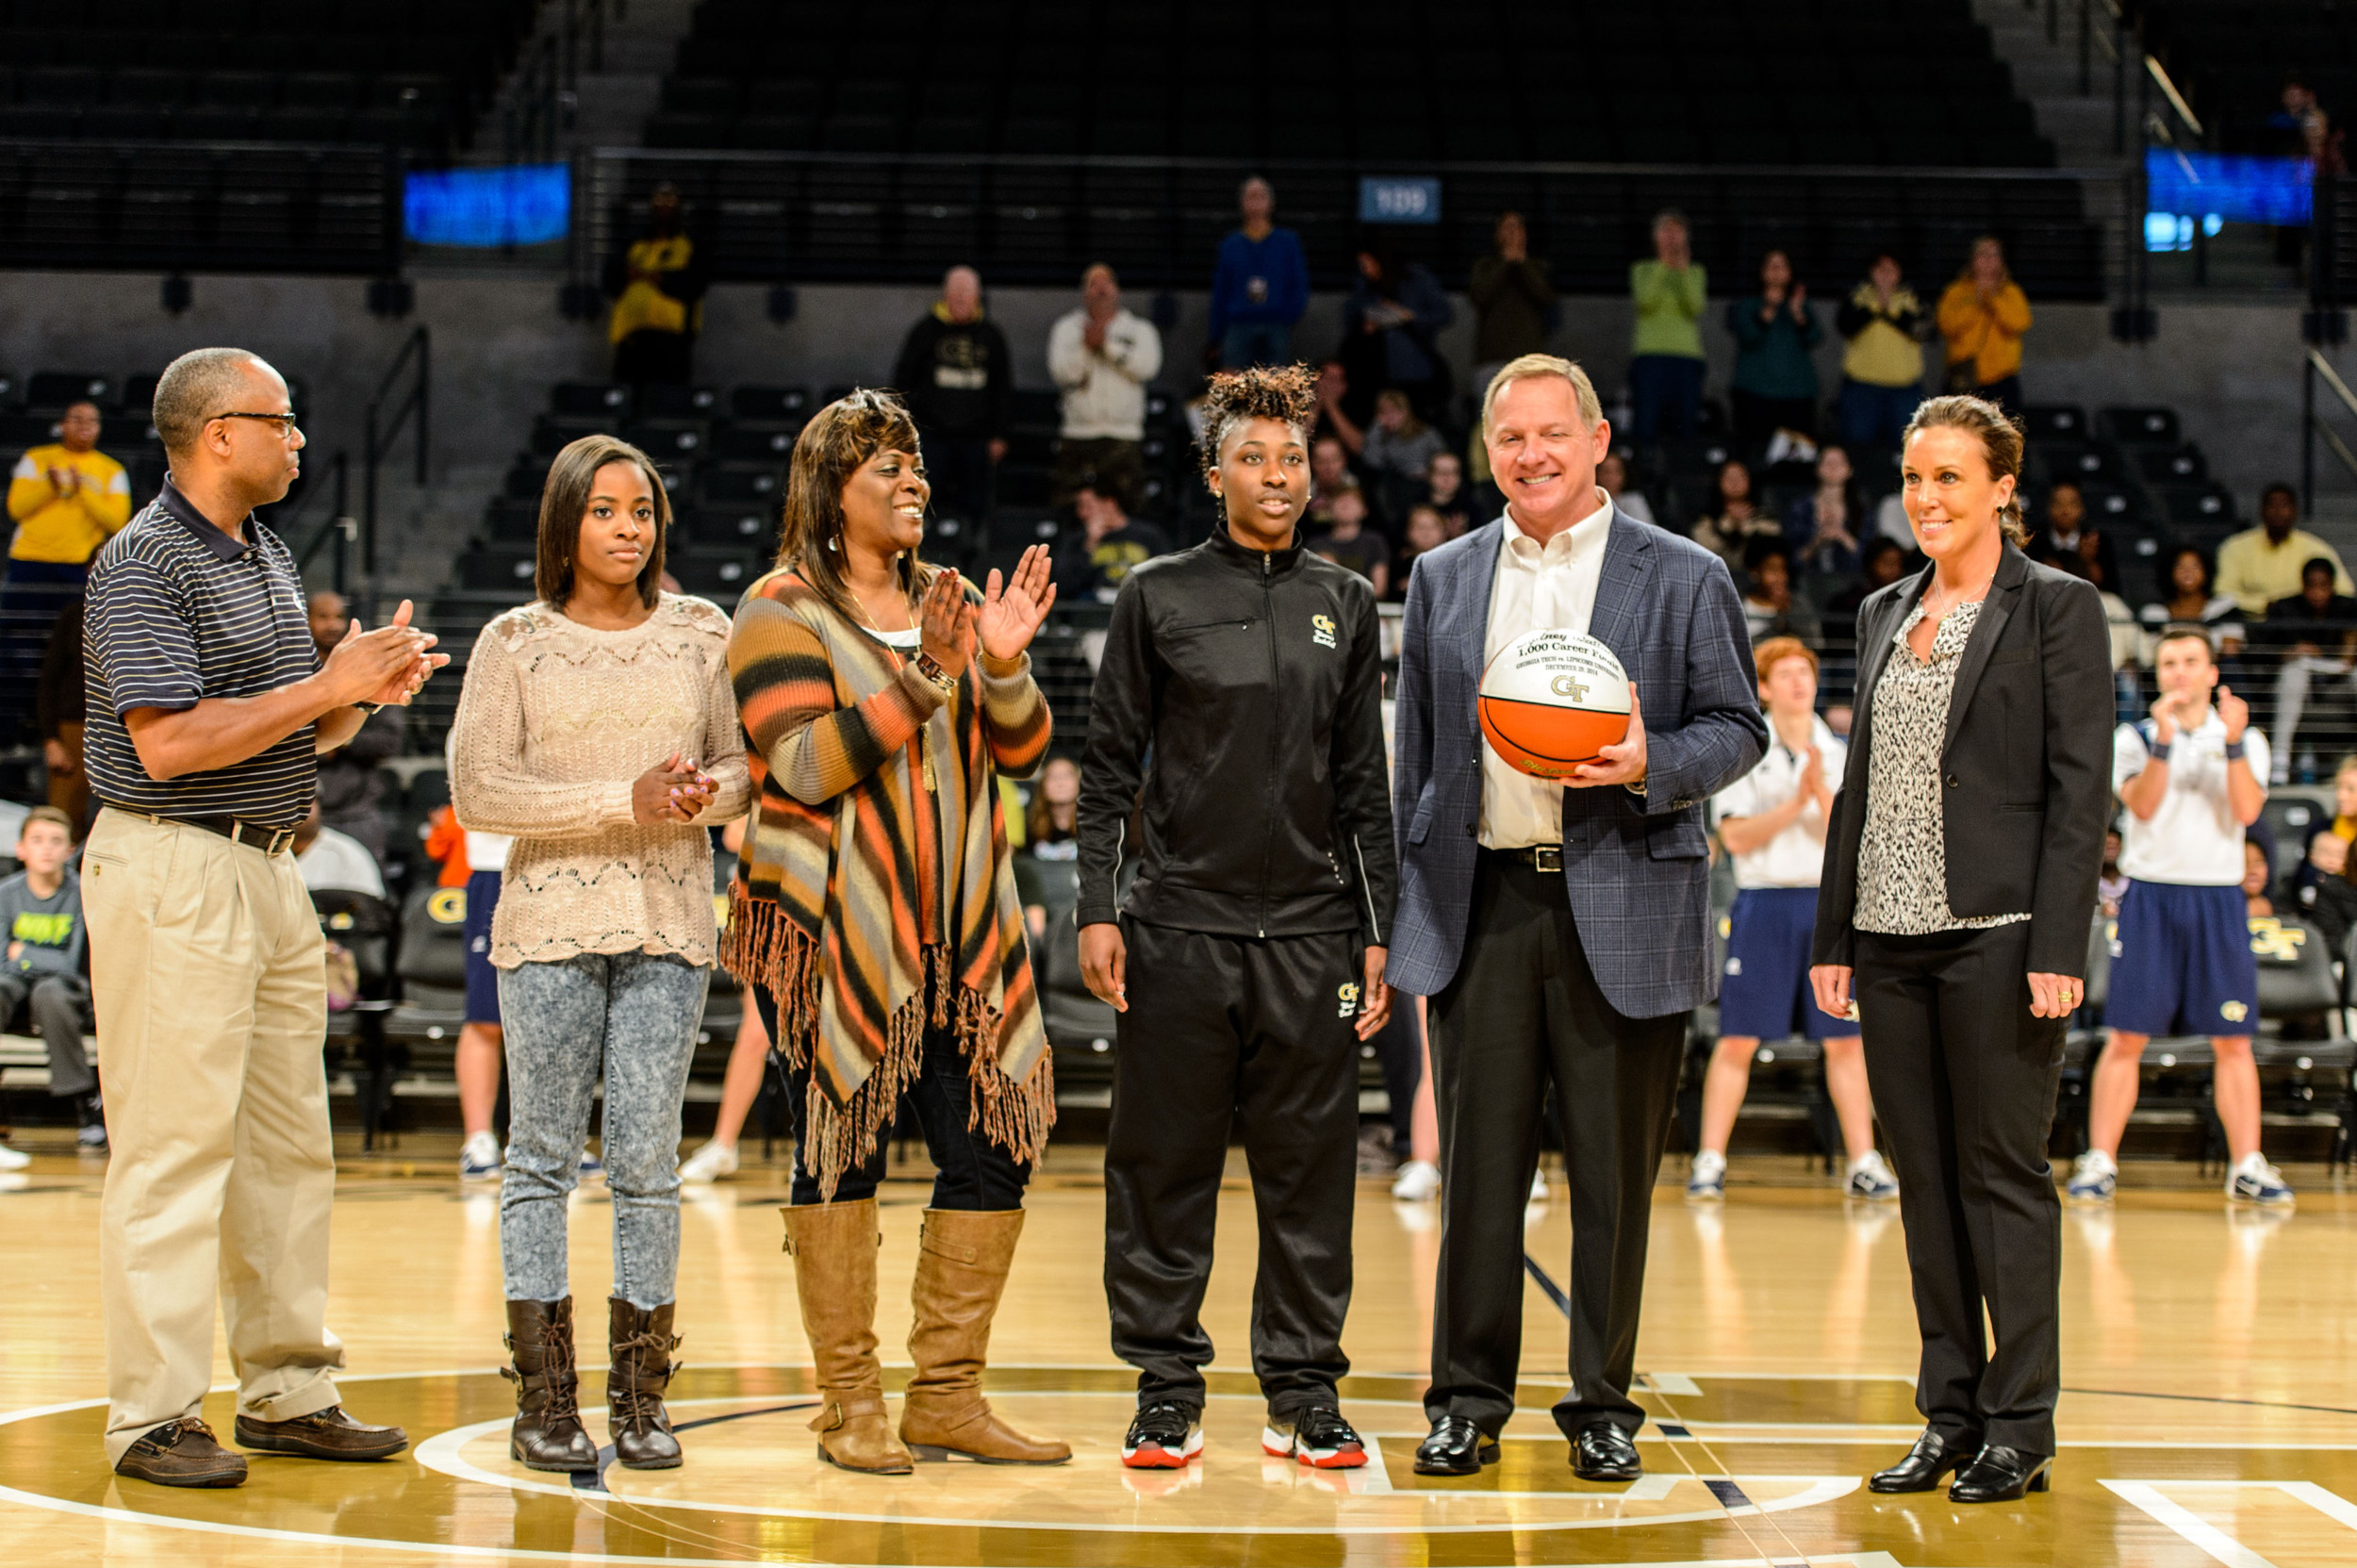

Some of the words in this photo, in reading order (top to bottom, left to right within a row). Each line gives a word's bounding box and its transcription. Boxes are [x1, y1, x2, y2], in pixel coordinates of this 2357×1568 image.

[1518, 643, 1548, 657] 1,000
[1552, 642, 1588, 654] Career
[1551, 674, 1590, 702] GT
